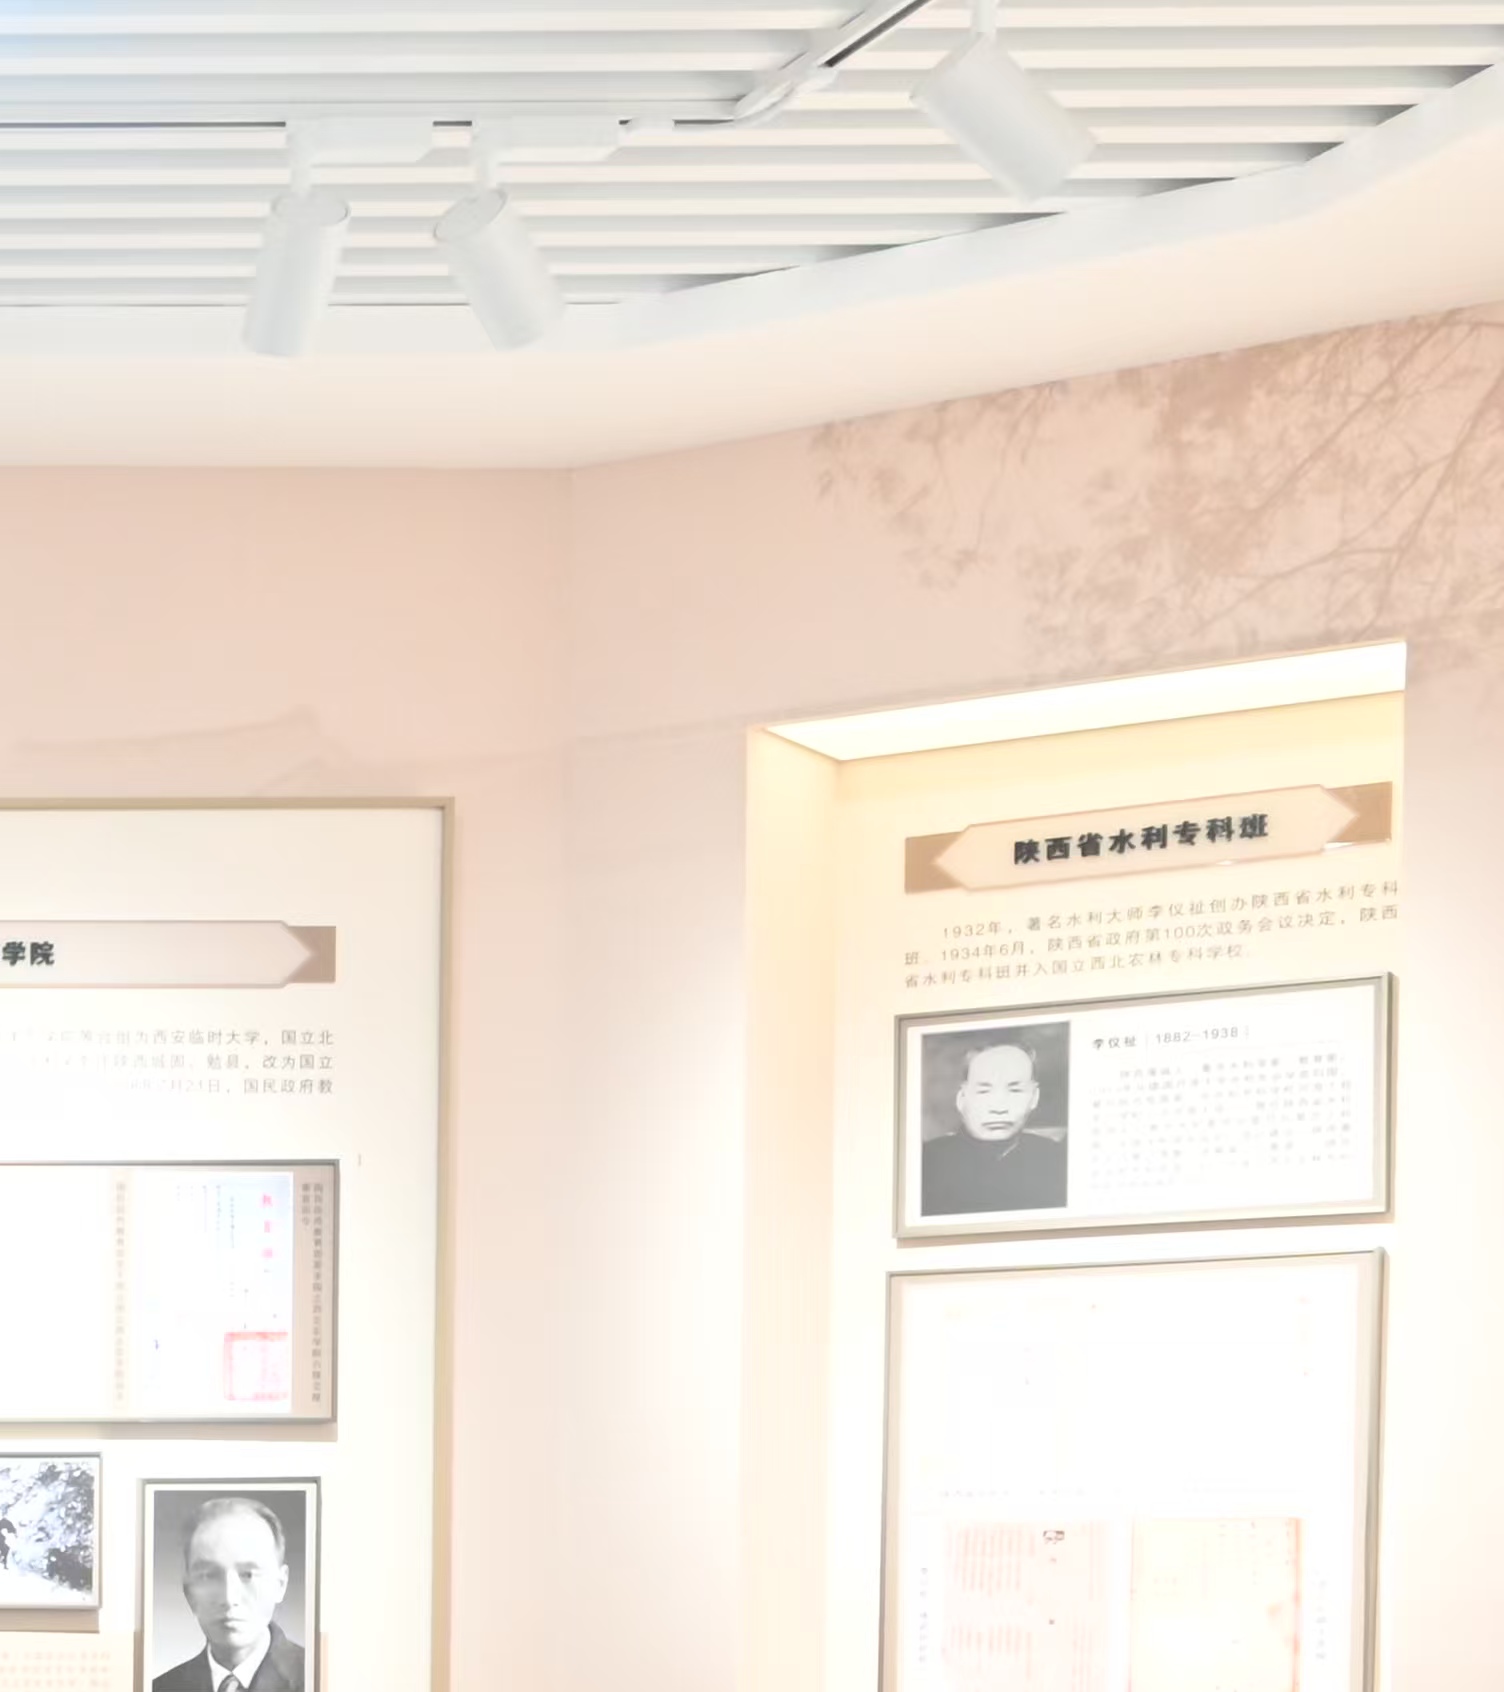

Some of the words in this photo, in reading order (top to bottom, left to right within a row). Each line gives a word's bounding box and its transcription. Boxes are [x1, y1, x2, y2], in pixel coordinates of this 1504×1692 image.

[1012, 812, 1270, 866] 陕西省水利专科班
[944, 879, 1399, 938] 1932年，著名水利大师李仪祉创办陕西省水利专科
